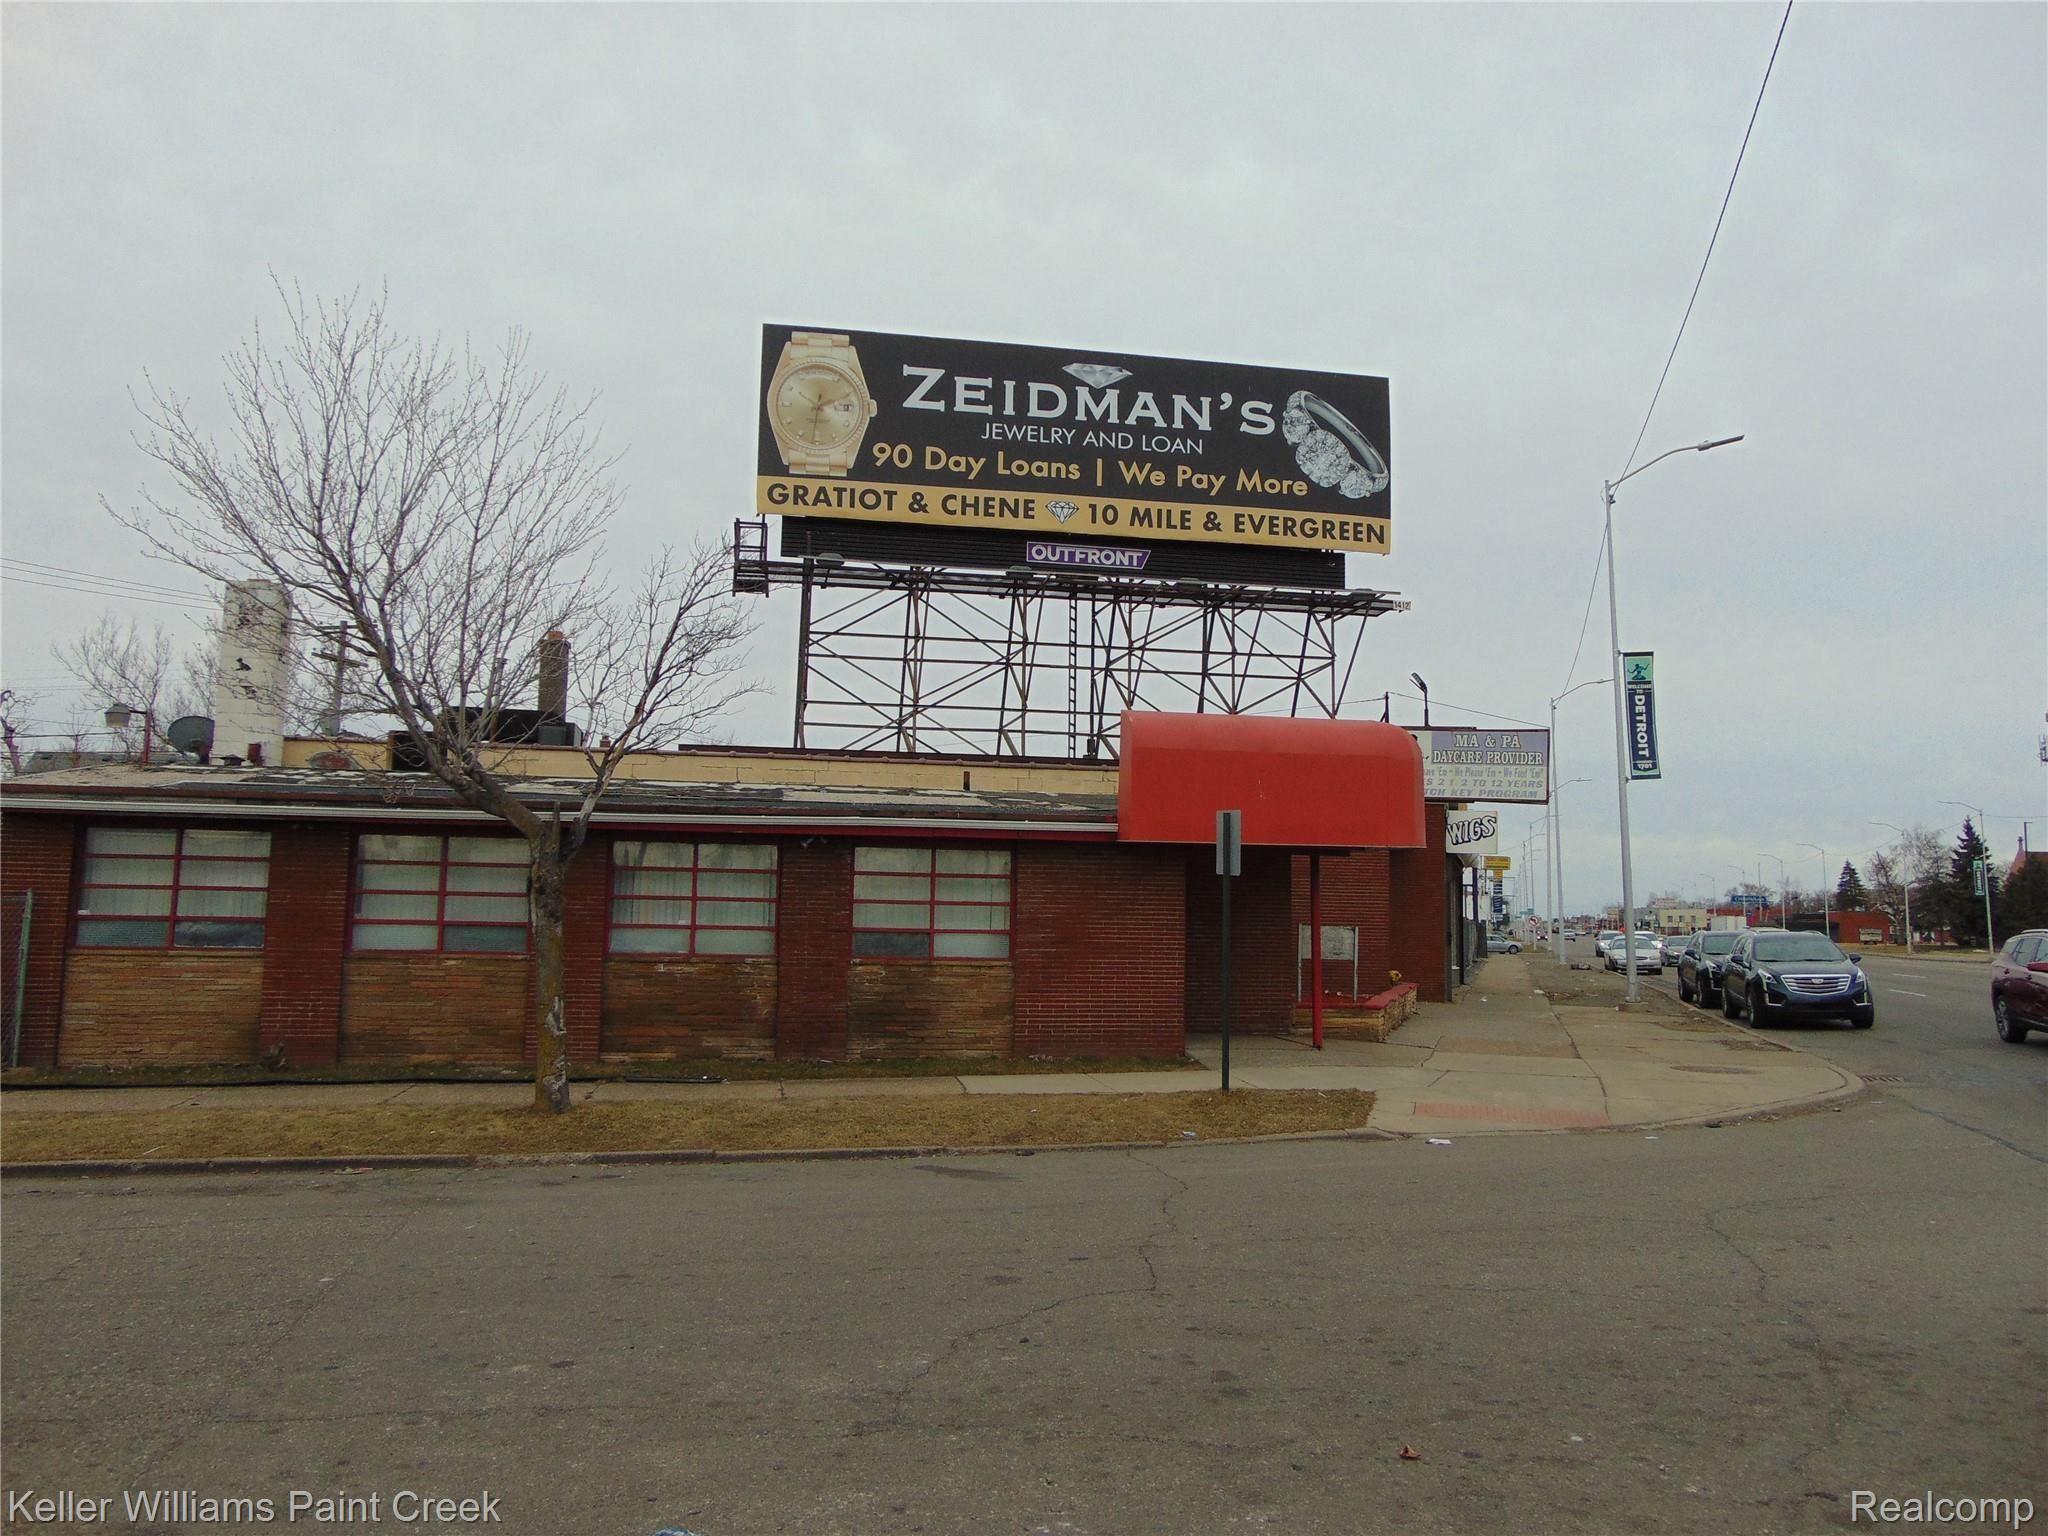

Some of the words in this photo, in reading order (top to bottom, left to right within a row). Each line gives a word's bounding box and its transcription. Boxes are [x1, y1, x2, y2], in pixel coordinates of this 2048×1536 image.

[902, 364, 1276, 435] ZEIDMAN'S
[981, 423, 1076, 445] JEWELRY
[1083, 431, 1133, 450] AND
[1142, 435, 1203, 455] LOAN
[872, 442, 913, 468] 90
[925, 446, 986, 480] Day
[997, 451, 1080, 480] Loans
[1119, 460, 1166, 487] We
[1177, 465, 1226, 496] Pay
[1236, 469, 1309, 497] More
[767, 482, 898, 511] GRATIOT
[908, 491, 930, 514] &
[941, 494, 1036, 519] CHENE
[1088, 503, 1119, 526] 10
[1130, 506, 1192, 531] MILE
[1203, 510, 1223, 533] &
[1234, 513, 1385, 545] EVERGREEN
[1031, 544, 1143, 567] OUTFRONT
[1455, 734, 1478, 748] MA
[1485, 735, 1496, 748] &
[1502, 735, 1521, 748] PA
[1634, 694, 1649, 758] DETROIT
[1432, 750, 1482, 764] DAYCARE
[1486, 751, 1543, 765] PROVIDER
[1438, 778, 1445, 786] 2
[1472, 779, 1486, 787] TO
[1507, 779, 1544, 788] YEARS
[1450, 788, 1473, 797] KEY
[1479, 789, 1538, 798] PROGRAM
[1448, 815, 1497, 846] WIGS
